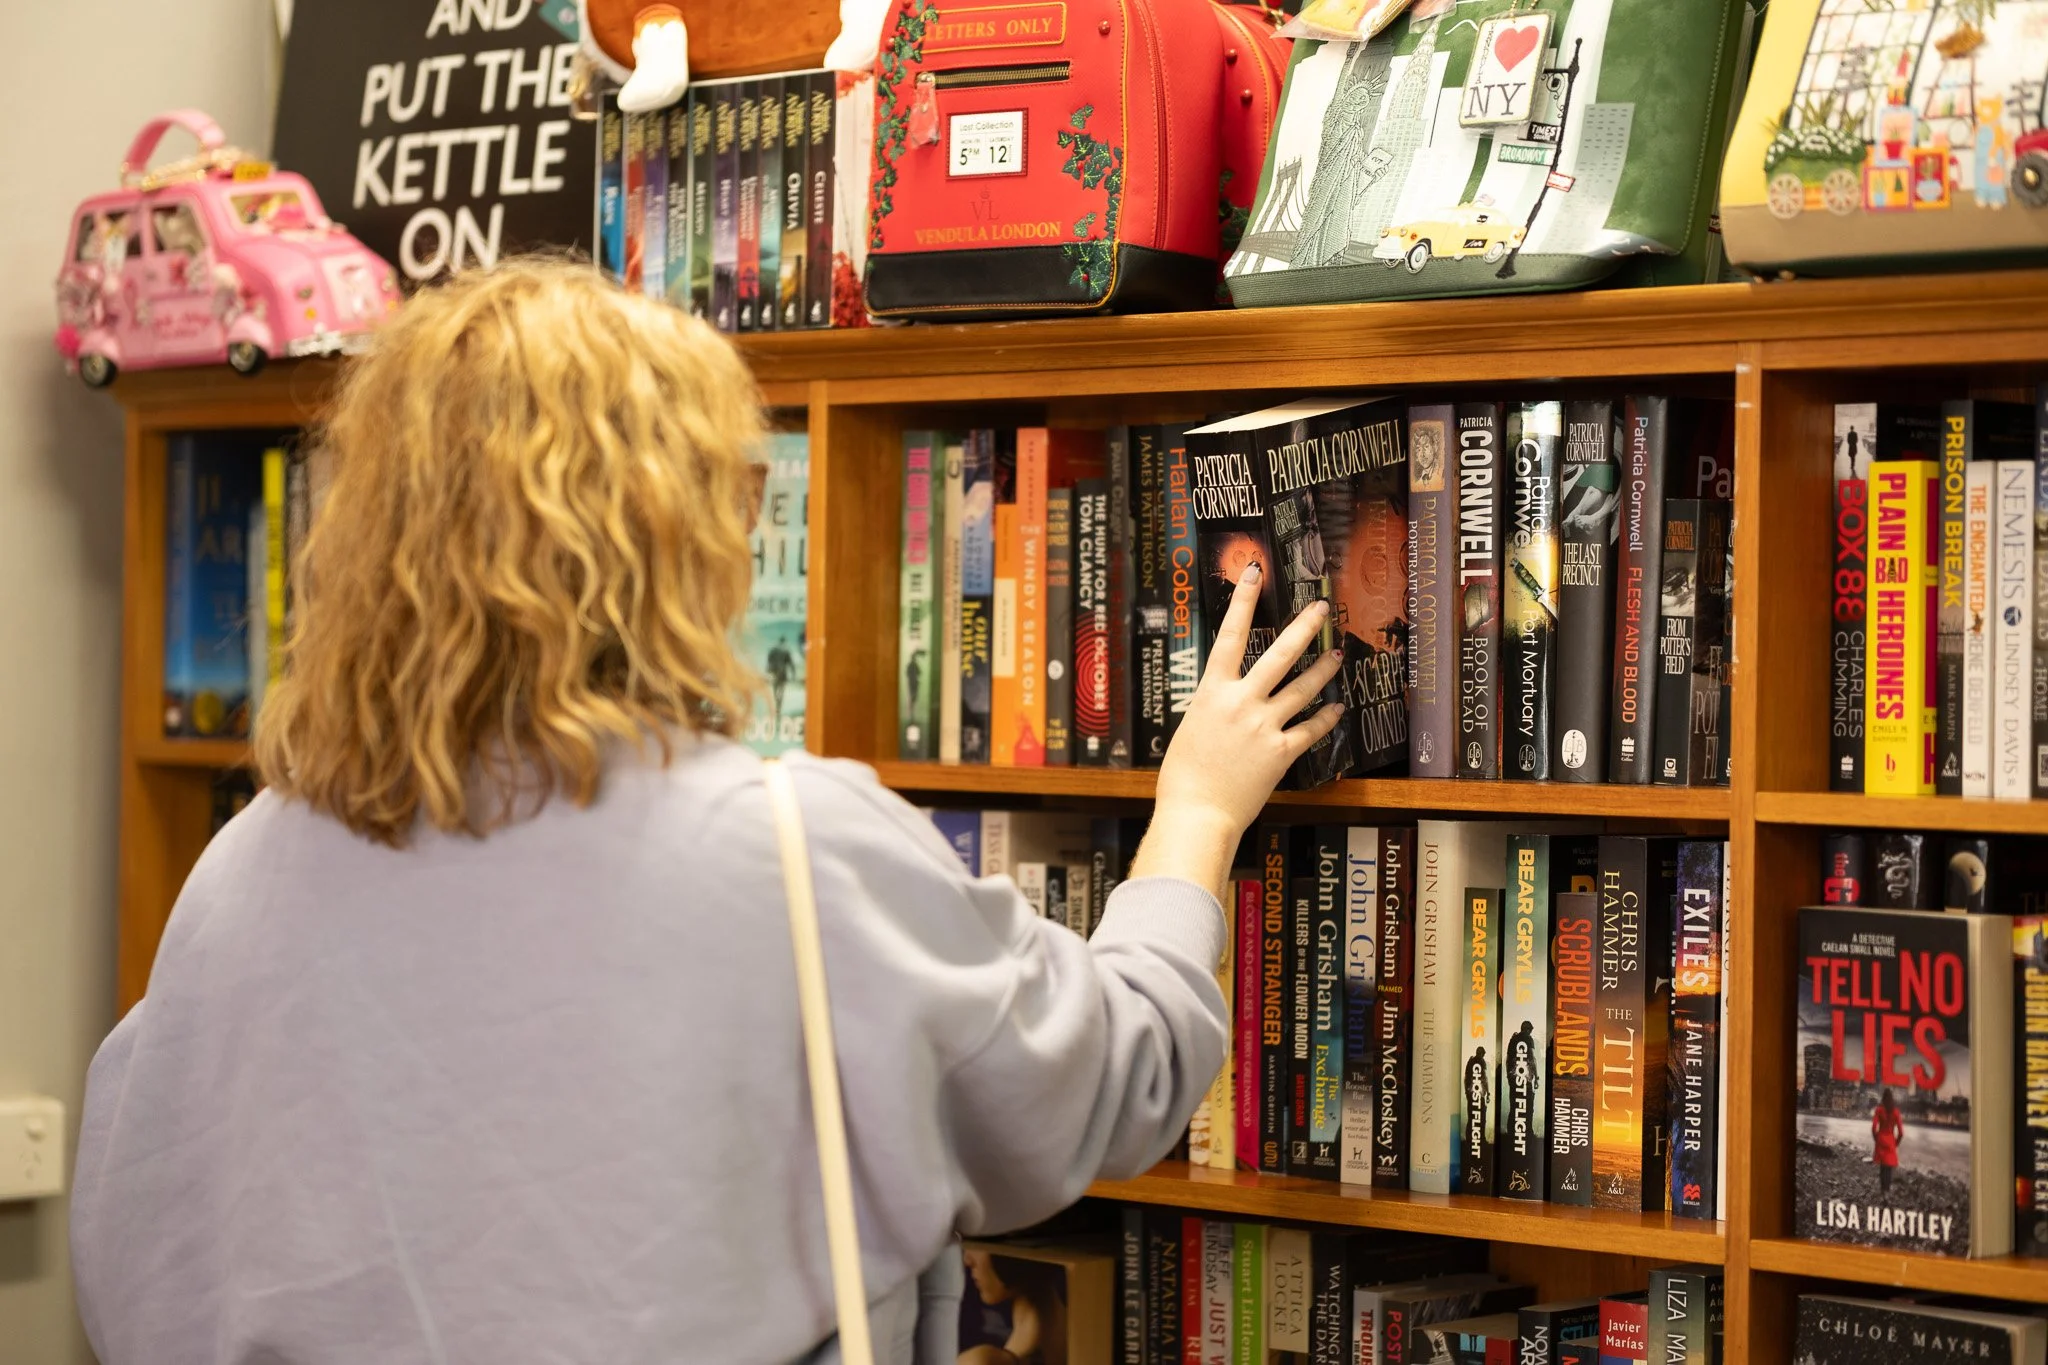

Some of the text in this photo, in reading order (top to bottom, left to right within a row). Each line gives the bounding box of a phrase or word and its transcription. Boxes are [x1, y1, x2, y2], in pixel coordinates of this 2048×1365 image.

[926, 17, 1053, 41] LETTERS ONLY
[360, 54, 467, 128] PUT
[976, 121, 1014, 131] Collection
[1464, 82, 1527, 119] NY
[1531, 124, 1556, 136] TIMES
[353, 120, 572, 209] KETTLE
[990, 145, 1007, 164] 12
[1500, 145, 1544, 162] BROADWAY
[786, 172, 801, 230] OLIVIA
[813, 171, 826, 225] CELESTE
[992, 221, 1062, 241] LONDON
[399, 203, 505, 281] ON
[1267, 419, 1406, 495] PATRICIA CORNWELL
[1460, 416, 1493, 429] PATRICIA
[1565, 441, 1607, 462] CORNWELL
[1569, 423, 1605, 443] PATRICIA
[1192, 485, 1264, 520] CORNWELL
[1194, 453, 1253, 488] PATRICIA
[1460, 429, 1493, 586] CORNWELL
[1629, 416, 1649, 552] Patricia Cornwell
[1140, 436, 1154, 589] JAMES PATTERSON
[1169, 447, 1195, 639] Harlan Coben
[1419, 496, 1437, 590] PATRICIA
[1834, 479, 1866, 622] BOX 88
[1878, 472, 1907, 551] PLAIN
[1943, 415, 1965, 609] PRISON BREAK
[1969, 485, 1987, 612] THE ENCHANTED
[2002, 467, 2027, 600] NEMESIS
[1079, 495, 1093, 609] TOM CLANCY
[1094, 494, 1107, 632] THE HUNT FOR RED
[1562, 564, 1602, 585] PRECINCT
[1564, 543, 1602, 565] THE LAST
[1408, 520, 1418, 689] PORTRAIT OF A KILLER
[1666, 618, 1687, 637] FROM
[1022, 620, 1036, 706] SEASON
[1142, 647, 1152, 719] IS MISSING
[1152, 638, 1164, 727] PRESIDENT
[1170, 647, 1198, 713] WIN
[1462, 634, 1474, 733] THE DEAD
[1474, 637, 1489, 731] BOOK OF
[1518, 609, 1539, 737] Port Mortuary
[1622, 567, 1643, 723] FLESH AND BLOOD
[1664, 656, 1685, 675] FIELD
[1833, 631, 1849, 737] CUMMING
[1848, 630, 1865, 739] CHARLES
[1876, 590, 1906, 720] HEROINES
[1946, 663, 1957, 741] MARK DAPIN
[2003, 632, 2021, 774] LINDSEY DAVIS
[1263, 833, 1283, 1046] THE SECOND STRANGER
[1316, 846, 1339, 1031] John Grisham
[1383, 839, 1401, 978] John Grisham
[1423, 841, 1439, 986] JOHN GRISHAM
[1515, 848, 1536, 1005] BEAR GRYLLS
[1602, 870, 1620, 991] HAMMER
[1621, 890, 1639, 972] CHRIS
[1681, 887, 1711, 988] EXILES
[1852, 933, 1897, 948] A DETECTIVE
[1243, 937, 1255, 964] AND
[1294, 899, 1309, 1060] KILLERS OF THE FLOWER MOON
[1345, 853, 1376, 1062] John Grisham
[1377, 984, 1404, 994] FRAMED
[1470, 898, 1487, 1039] BEAR GRYLLS
[1806, 949, 1966, 1018] TELL NO
[1849, 944, 1873, 956] SMALL
[1872, 946, 1897, 958] NOVEL
[1382, 1000, 1399, 1039] Jim
[1556, 918, 1593, 1076] SCRUBLANDS
[1605, 1007, 1633, 1021] THE
[1312, 1044, 1329, 1130] Exchange
[1328, 1076, 1340, 1100] The
[1344, 1081, 1374, 1092] Rooster
[1352, 1071, 1367, 1081] The
[1421, 1007, 1436, 1125] THE SUMMONS
[1602, 1027, 1635, 1143] TILT
[1684, 1019, 1703, 1152] JANE HARPER
[1832, 1009, 1948, 1090] LIES
[1267, 1054, 1276, 1134] MARTIN GRIFFIN
[1376, 1044, 1398, 1150] McCloskey
[1471, 1063, 1482, 1158] GHOST FLIGHT
[1513, 1041, 1528, 1156] GHOST FLIGHT
[1553, 1097, 1571, 1154] HAMMER
[1571, 1107, 1589, 1147] CHRIS
[1607, 1186, 1625, 1195] A&U
[1816, 1200, 1954, 1243] LISA HARTLEY
[1124, 1231, 1140, 1310] JOHN LE
[1161, 1241, 1177, 1345] NATASHA
[1218, 1242, 1231, 1280] JEFF
[1241, 1239, 1255, 1294] Stuart
[1274, 1261, 1288, 1333] LOCKE
[1290, 1255, 1303, 1336] ATTICA
[1667, 1278, 1688, 1320] LIZA
[1209, 1298, 1226, 1348] JUST
[1315, 1291, 1328, 1324] THE
[1328, 1264, 1342, 1355] WATCHING
[1387, 1310, 1403, 1362] POST
[1605, 1334, 1644, 1351] Marías
[1607, 1319, 1641, 1334] Javier
